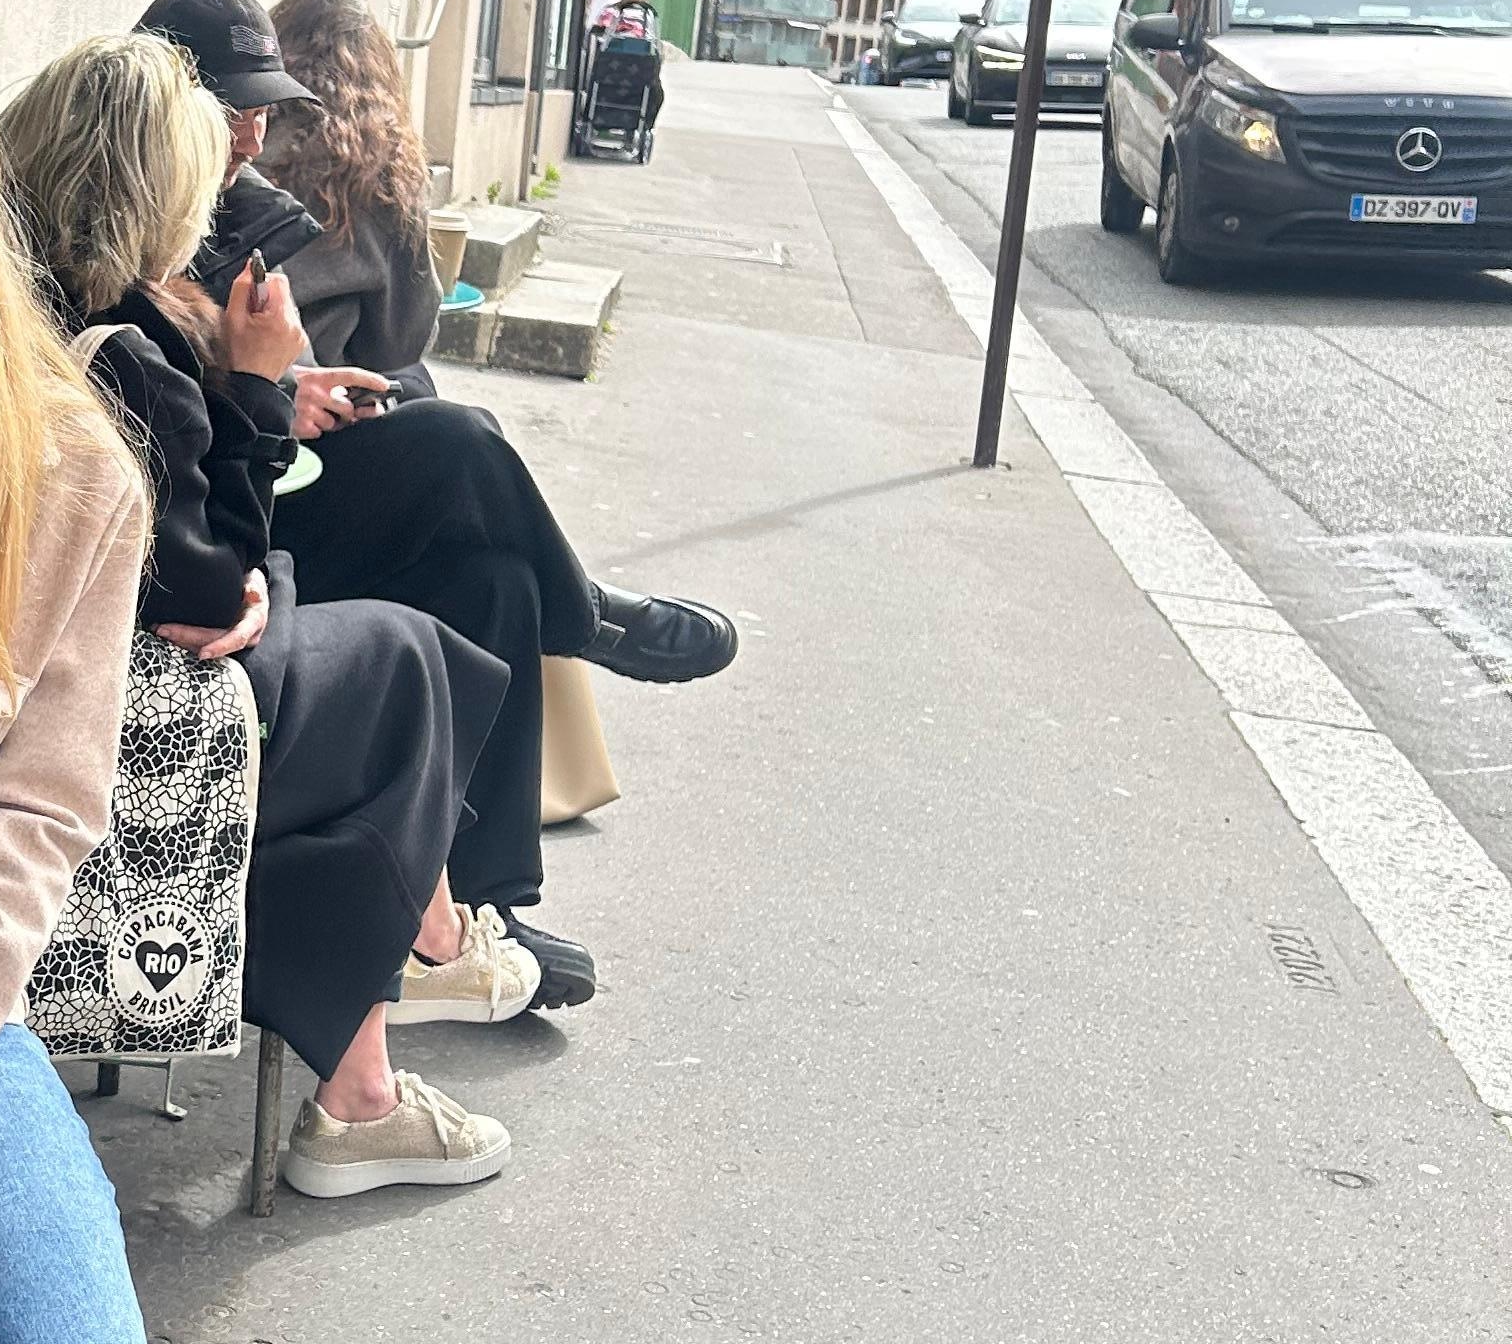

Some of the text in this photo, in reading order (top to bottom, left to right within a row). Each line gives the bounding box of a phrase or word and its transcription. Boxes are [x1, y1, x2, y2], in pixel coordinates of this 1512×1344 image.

[117, 910, 204, 965] COPACABANA
[144, 952, 181, 974] RIO
[128, 991, 186, 1017] BRASIL
